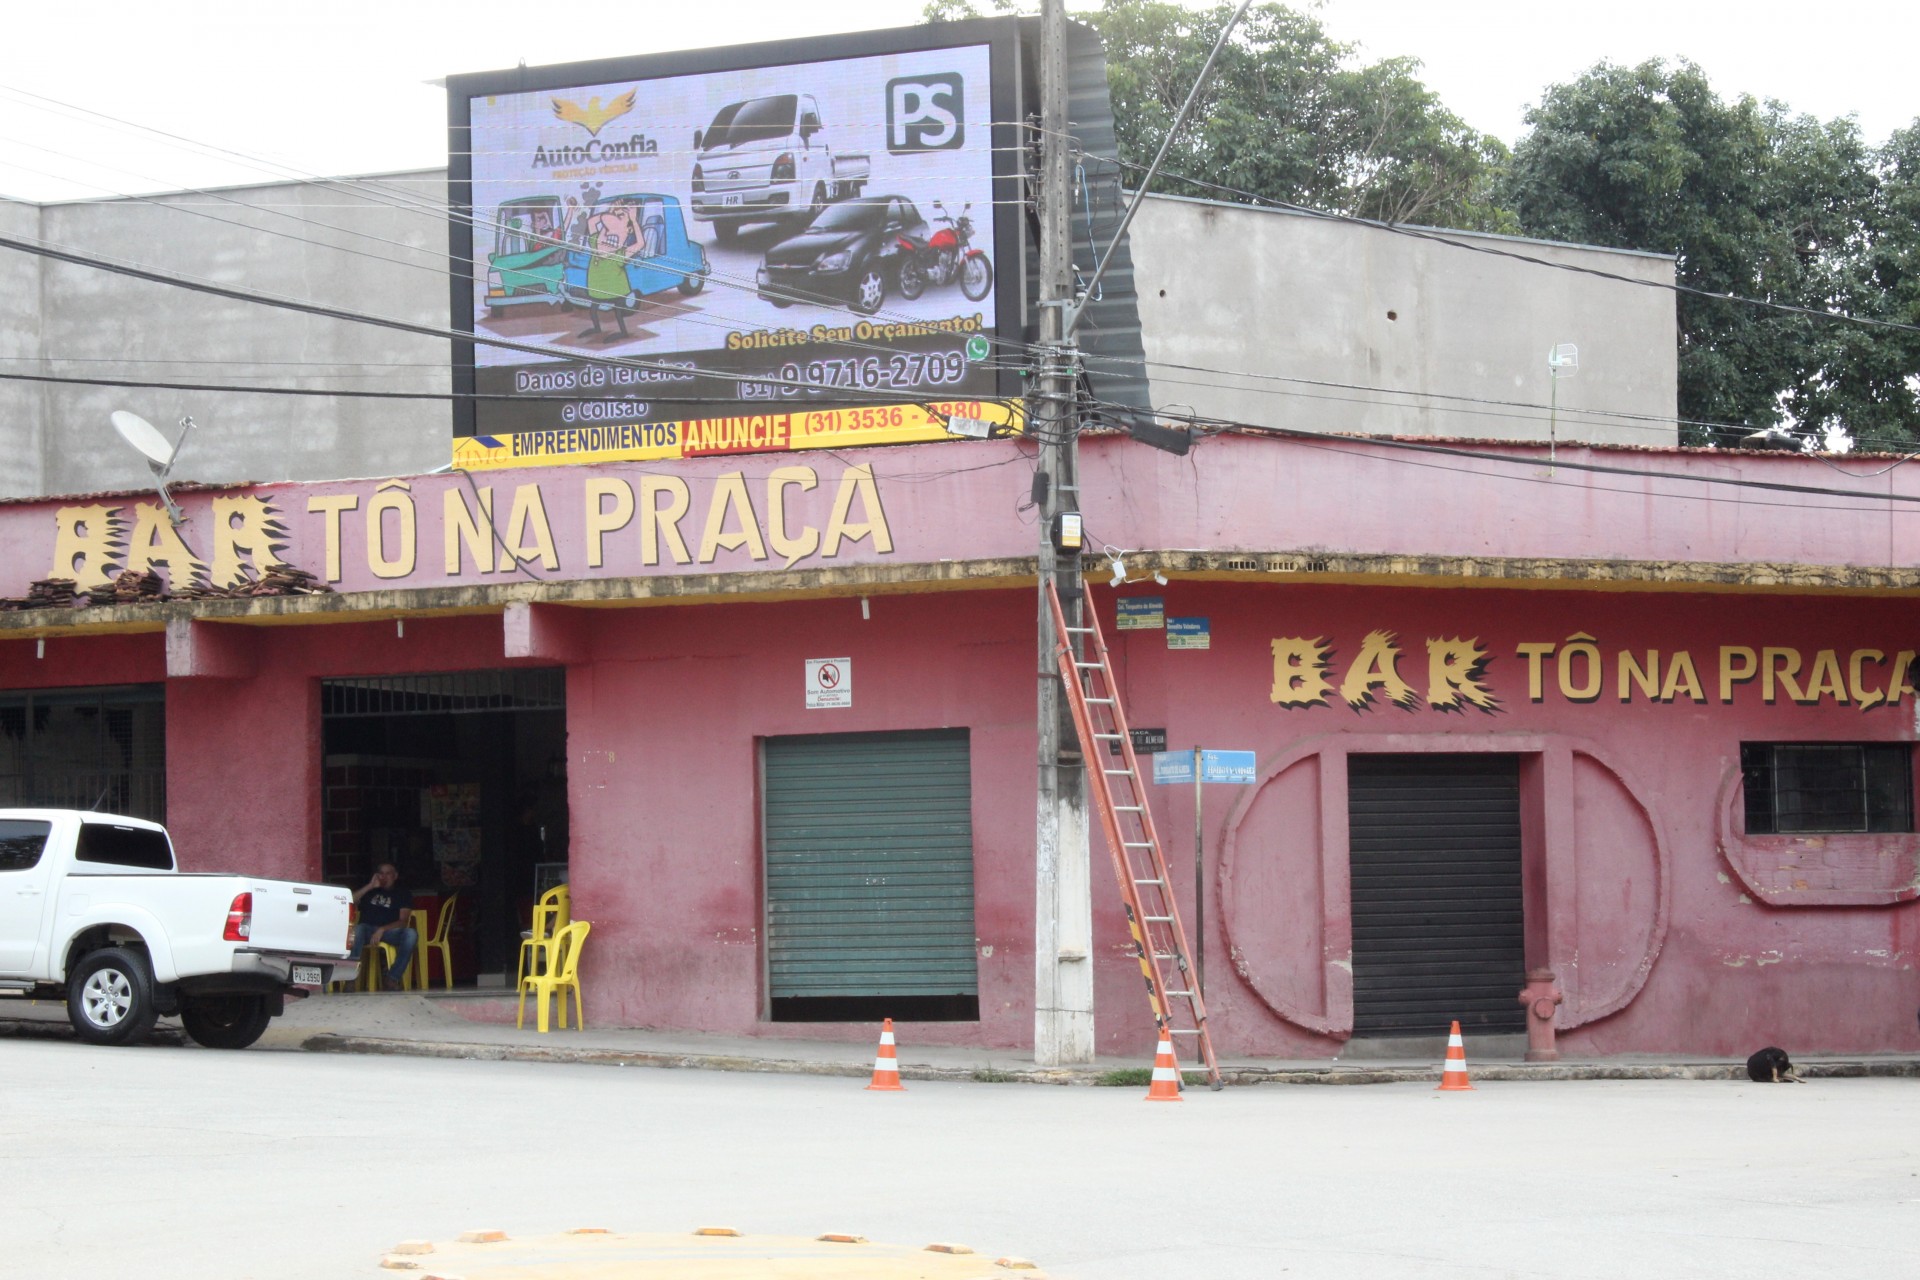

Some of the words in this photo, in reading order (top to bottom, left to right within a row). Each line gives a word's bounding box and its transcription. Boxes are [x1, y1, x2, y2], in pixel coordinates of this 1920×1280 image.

[893, 83, 957, 146] PS
[531, 134, 659, 168] AutoConfia
[725, 195, 739, 205] HR
[727, 327, 807, 350] Solicite
[812, 323, 851, 342] Seu
[854, 313, 983, 342] Orçamento!
[516, 370, 576, 392] Danos
[580, 364, 604, 387] de
[608, 359, 696, 385] Terceiros
[736, 372, 776, 400] (31)
[780, 363, 800, 395] 9
[806, 351, 965, 392] 9716-2709
[562, 404, 575, 422] e
[579, 395, 649, 421] Colisão
[512, 422, 677, 457] EMPREENDIMENTOS
[683, 419, 787, 451] ANUNCIE
[804, 410, 842, 435] (31)
[848, 406, 903, 431] 3536
[52, 494, 290, 593] BAR
[308, 478, 417, 583] TÔ
[443, 483, 560, 576] NA
[585, 463, 894, 571] PRAÇA
[1270, 628, 1508, 717] BAR
[1516, 631, 1602, 704] TÔ
[1618, 649, 1708, 704] NA
[1719, 645, 1917, 713] PRAÇA
